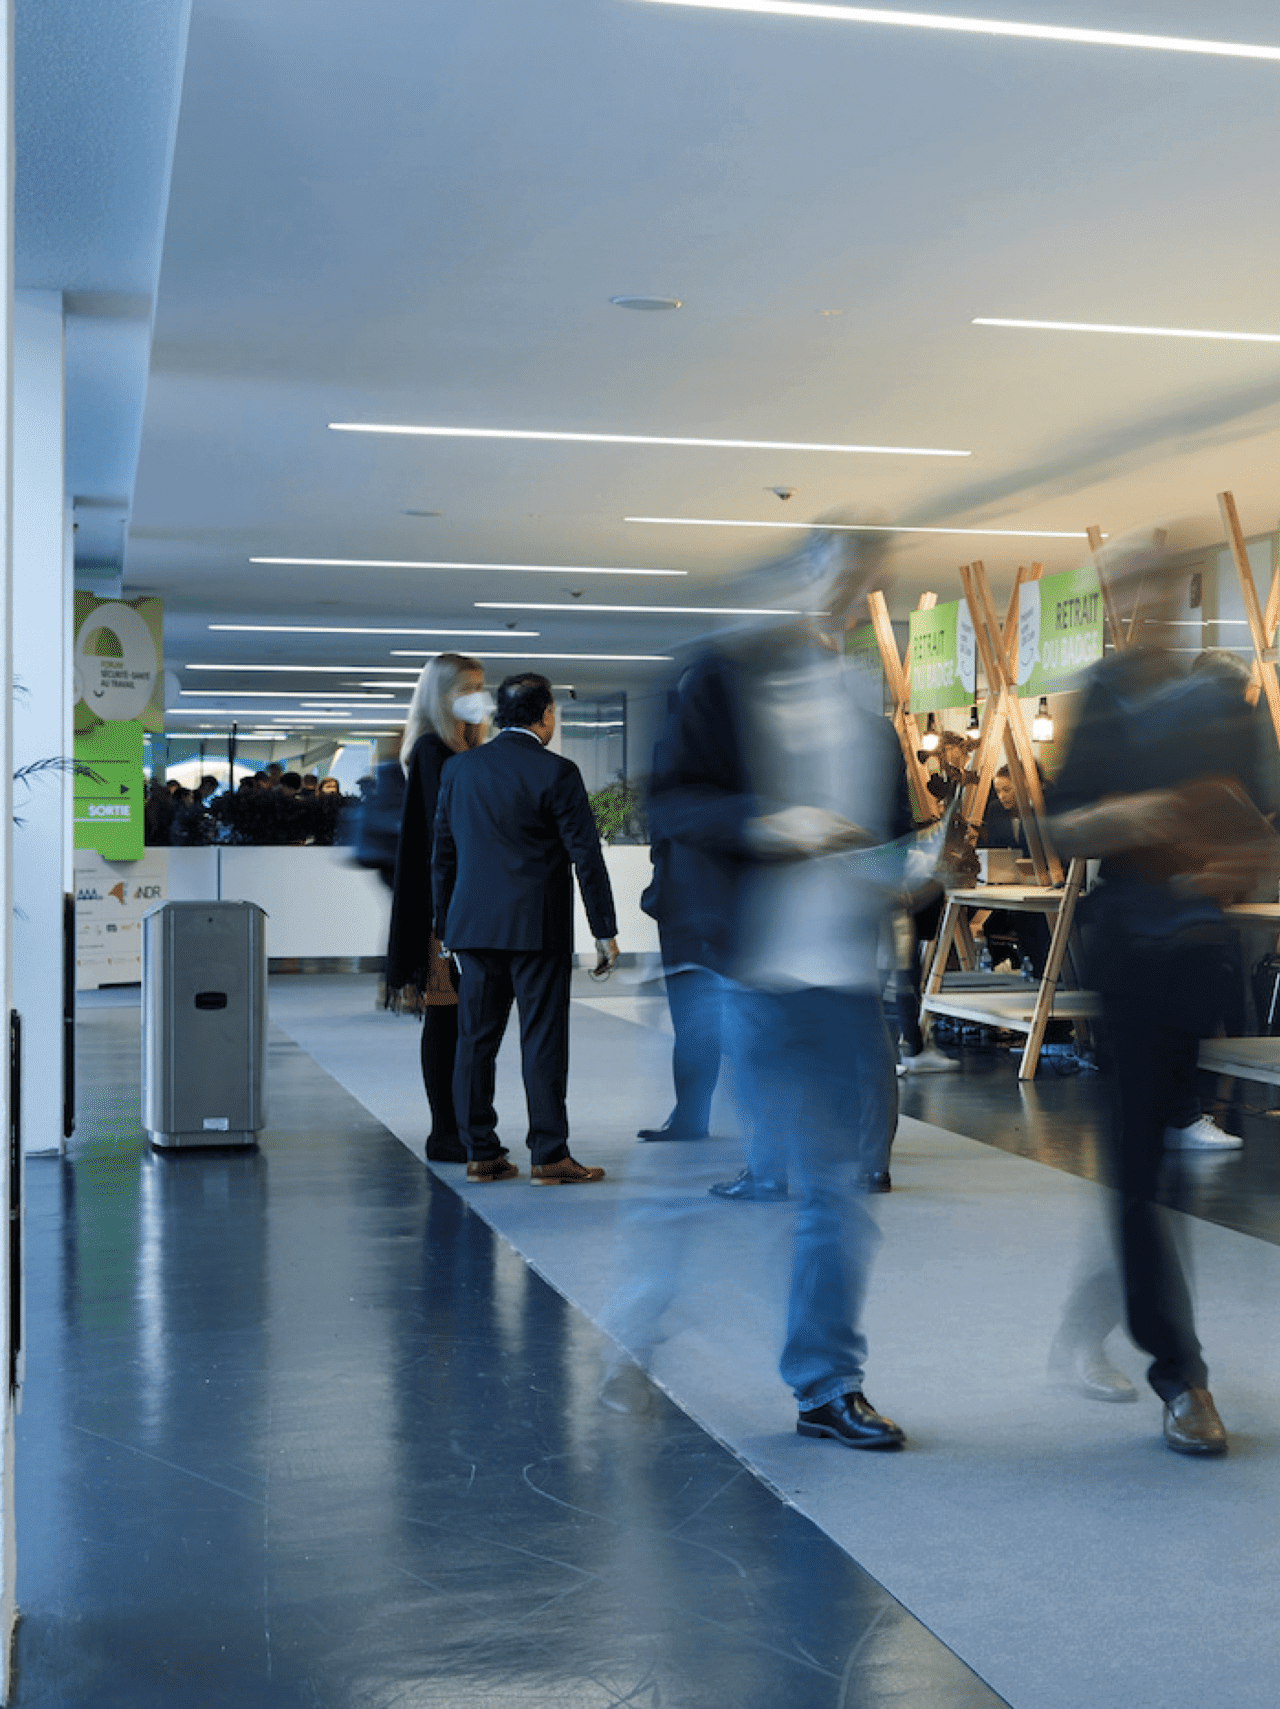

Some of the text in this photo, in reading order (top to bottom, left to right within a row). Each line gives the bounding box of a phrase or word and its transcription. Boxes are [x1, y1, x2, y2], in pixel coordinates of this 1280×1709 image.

[1056, 592, 1099, 631] RETRAIT
[112, 680, 135, 690] TRAVAIL
[88, 804, 131, 817] SORTIE
